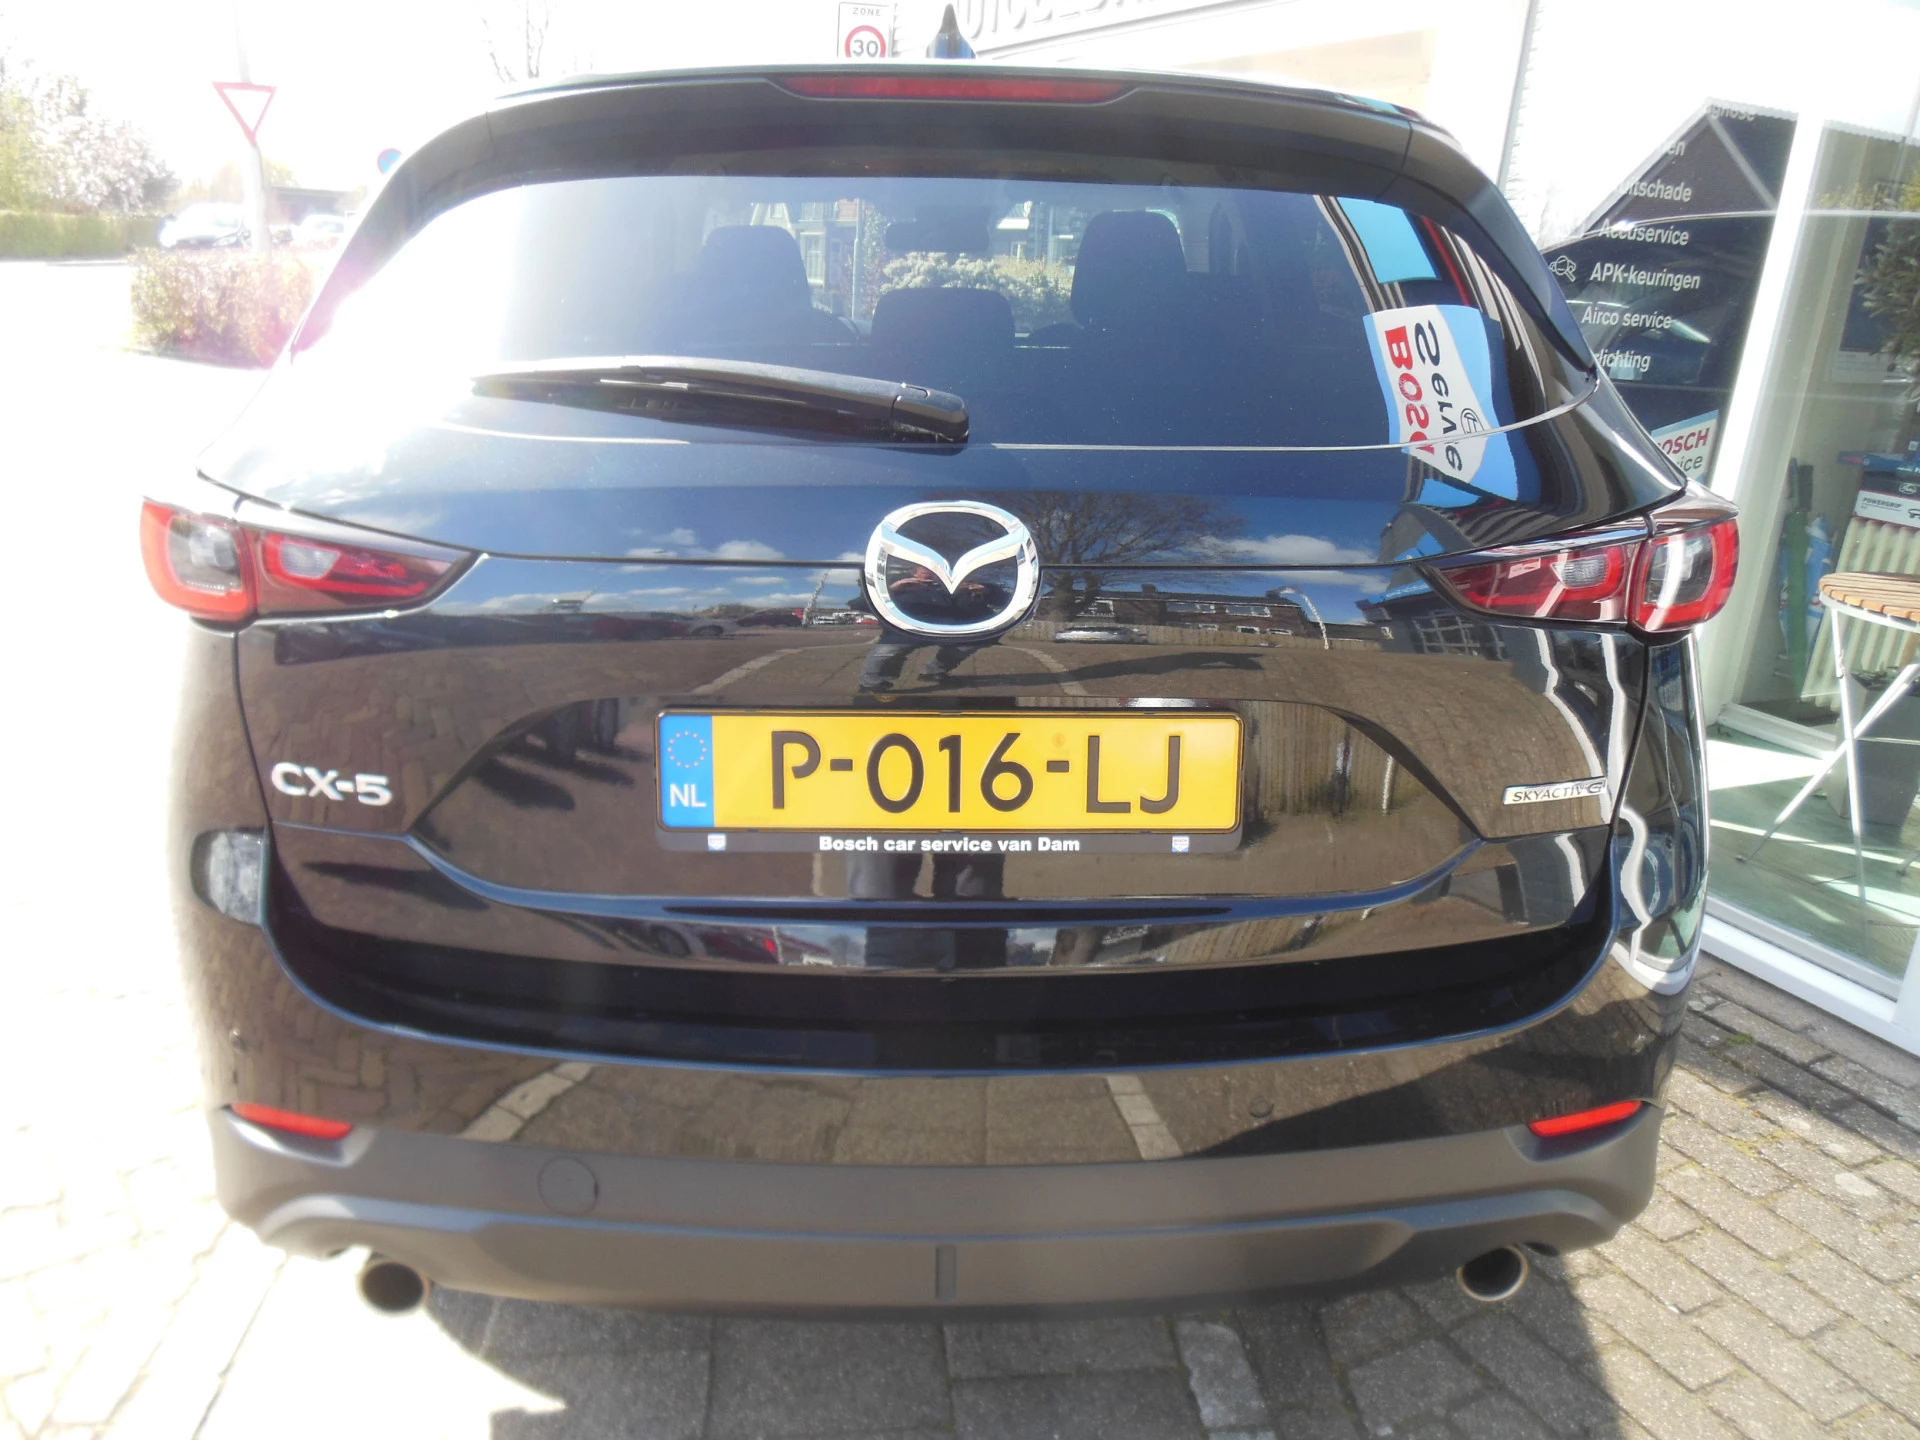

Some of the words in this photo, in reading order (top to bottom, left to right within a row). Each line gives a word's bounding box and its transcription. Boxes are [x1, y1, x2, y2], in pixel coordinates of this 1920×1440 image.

[852, 7, 881, 17] ZONE
[852, 39, 879, 58] 30
[1589, 262, 1701, 291] APK-keuringen
[1581, 306, 1618, 326] Airco
[1622, 311, 1673, 330] service
[1657, 426, 1711, 455] OSCH
[271, 761, 393, 806] CX-5
[771, 730, 1181, 815] P-016-LJ
[669, 784, 706, 809] NL
[818, 836, 880, 853] Bosch
[882, 840, 916, 853] car
[920, 837, 993, 853] service
[996, 841, 1033, 853] van
[1037, 838, 1081, 852] Dam
